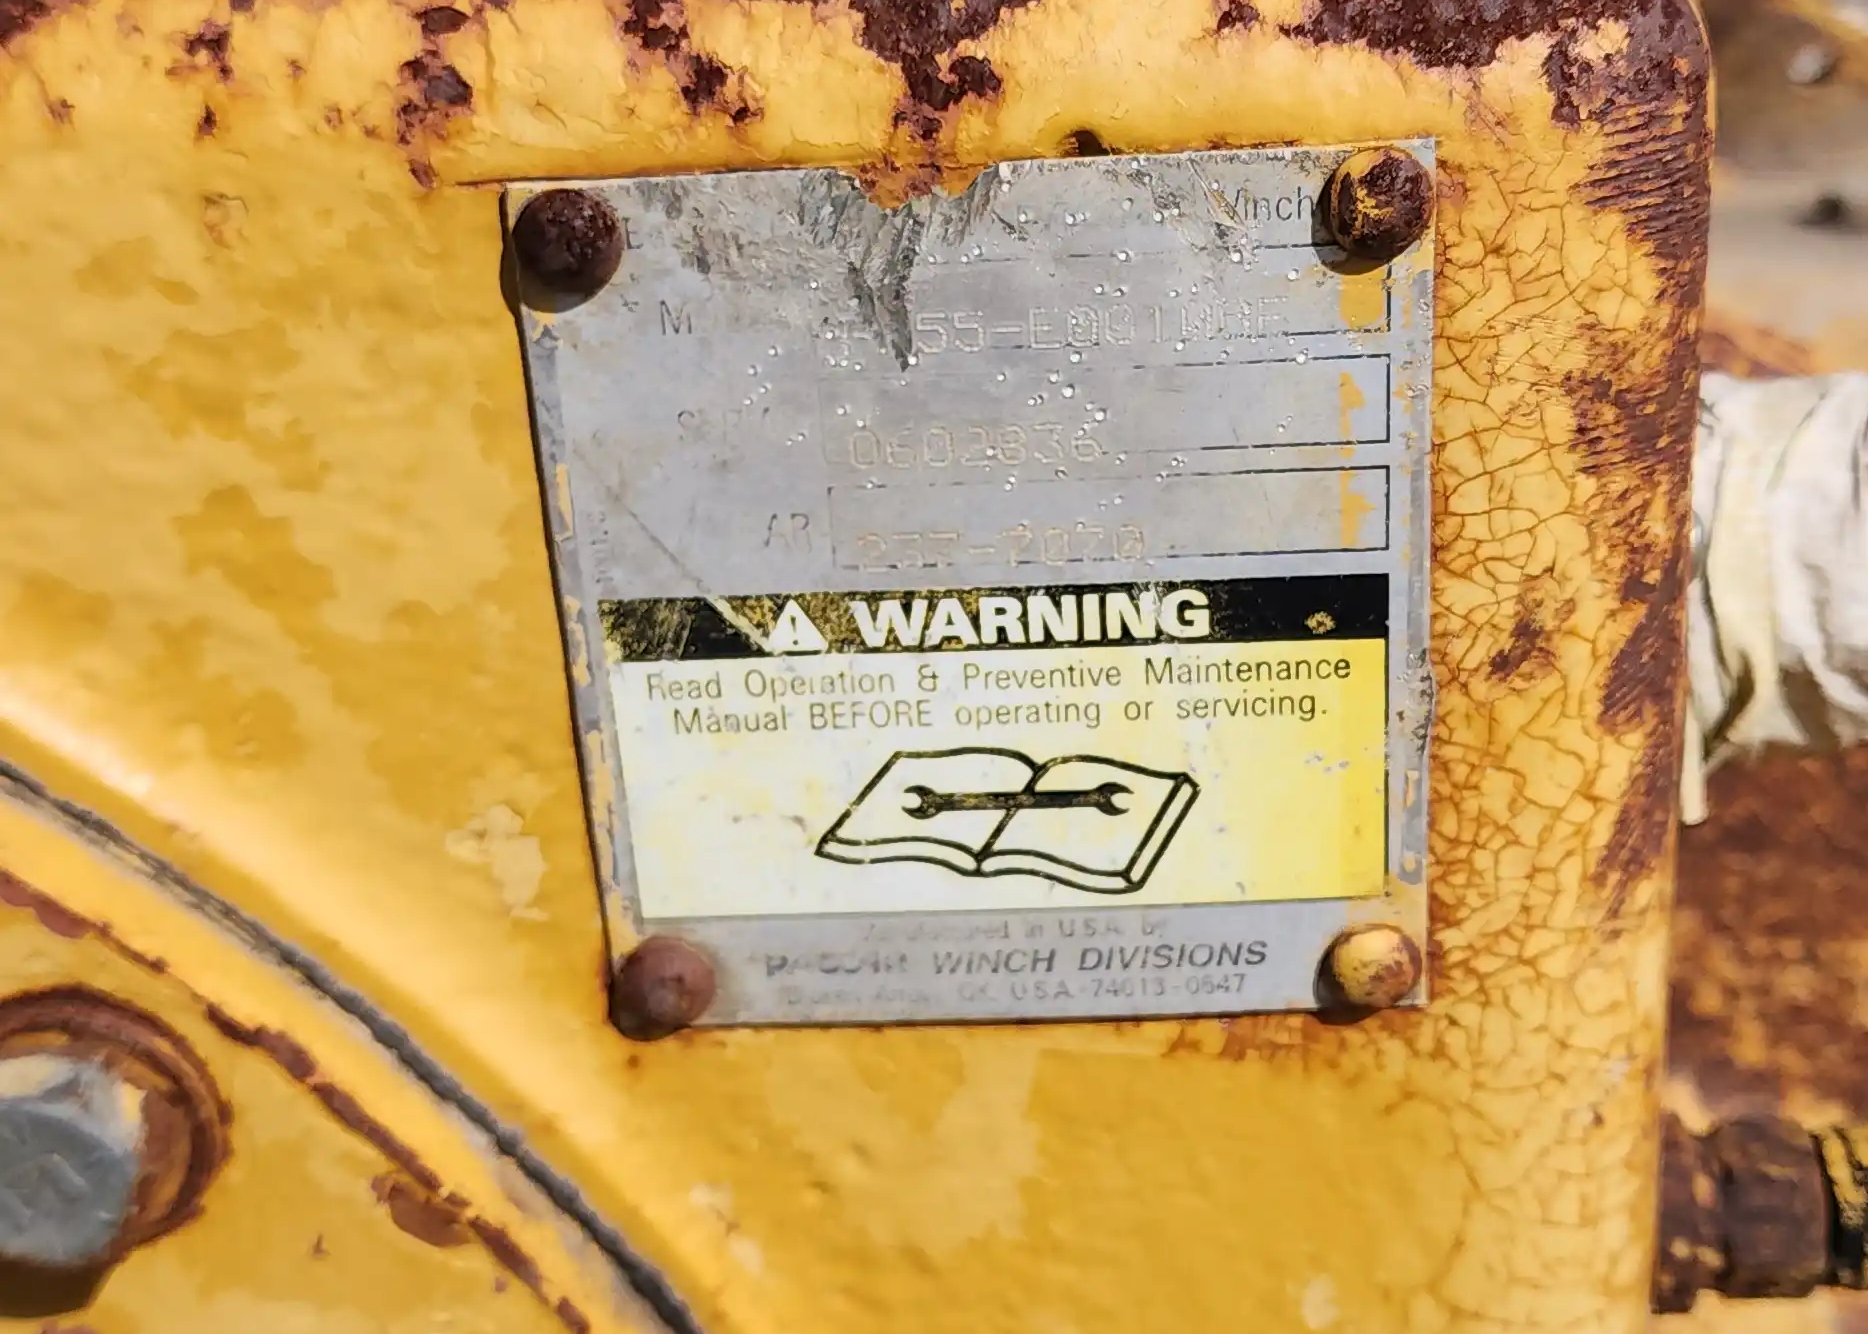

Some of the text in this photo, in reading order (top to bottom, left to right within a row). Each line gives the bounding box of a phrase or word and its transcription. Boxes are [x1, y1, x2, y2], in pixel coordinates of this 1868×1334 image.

[849, 421, 1103, 470] 0602836
[850, 588, 1212, 647] WARNING
[647, 654, 1352, 703] Read Operation & Preventive Maintenance
[673, 687, 1329, 736] Manual BEFORE operating or servicing.
[931, 946, 1058, 975] WINCH
[1077, 939, 1269, 972] DIVISIONS
